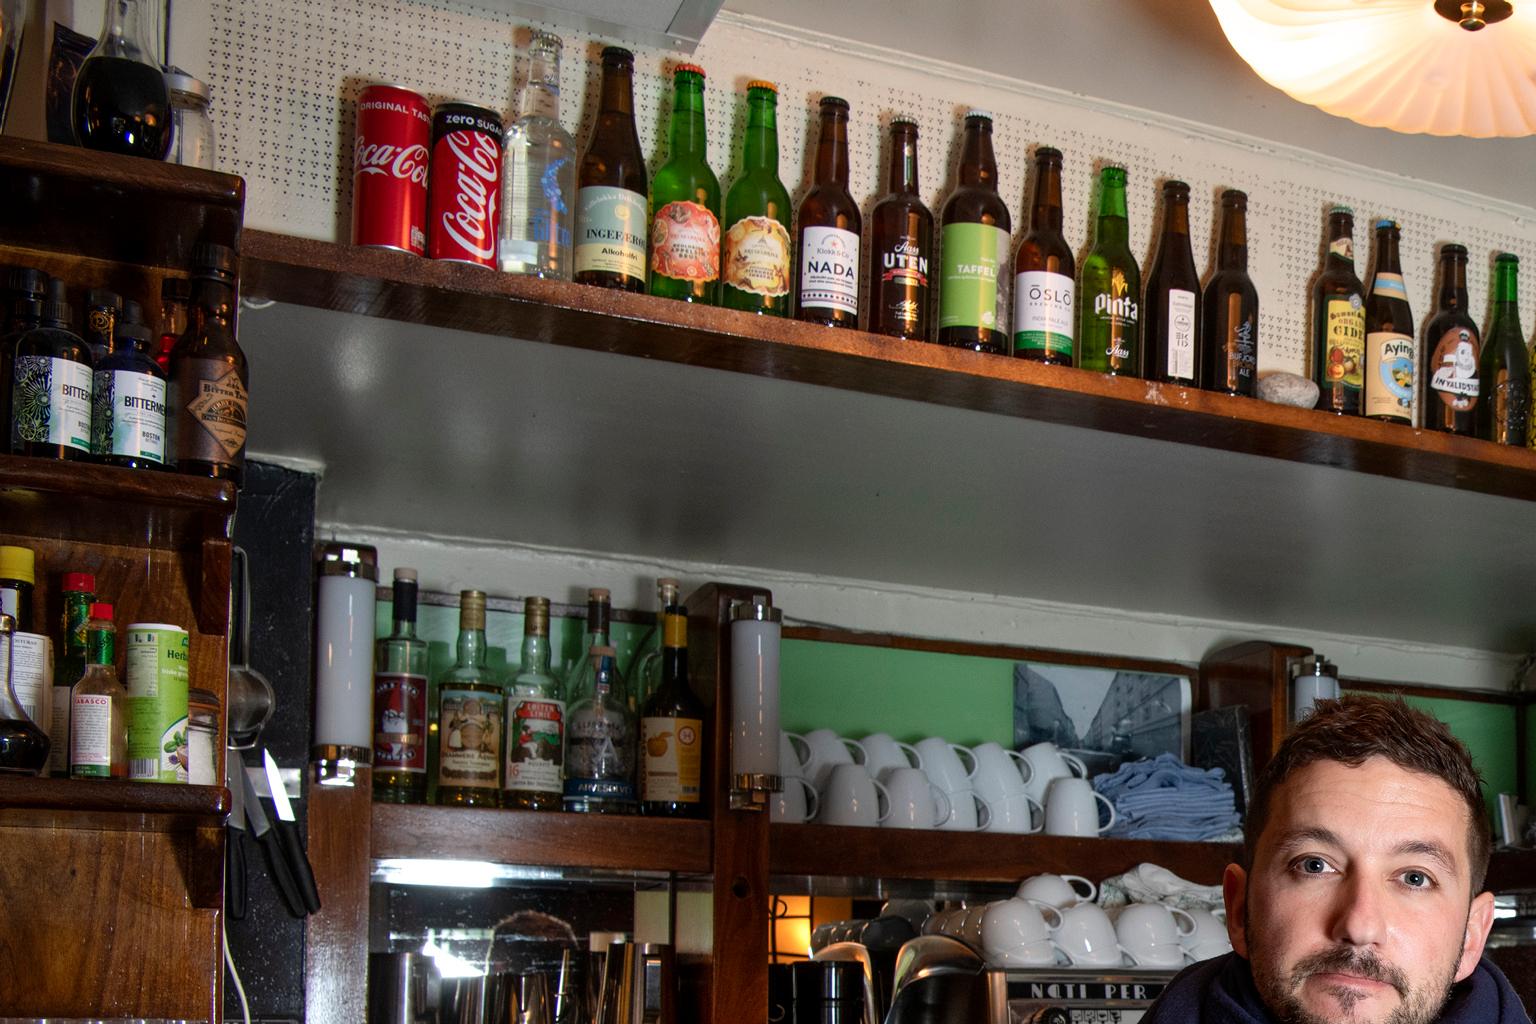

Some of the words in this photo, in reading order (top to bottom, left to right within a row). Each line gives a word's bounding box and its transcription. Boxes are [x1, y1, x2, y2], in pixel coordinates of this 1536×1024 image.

[360, 100, 409, 114] ORIGINAL
[446, 114, 475, 126] zero
[807, 260, 854, 280] NADA
[884, 251, 928, 275] UTEN
[957, 264, 996, 278] TAFFEL
[141, 430, 161, 443] BOSTON
[1105, 983, 1148, 1000] PER
